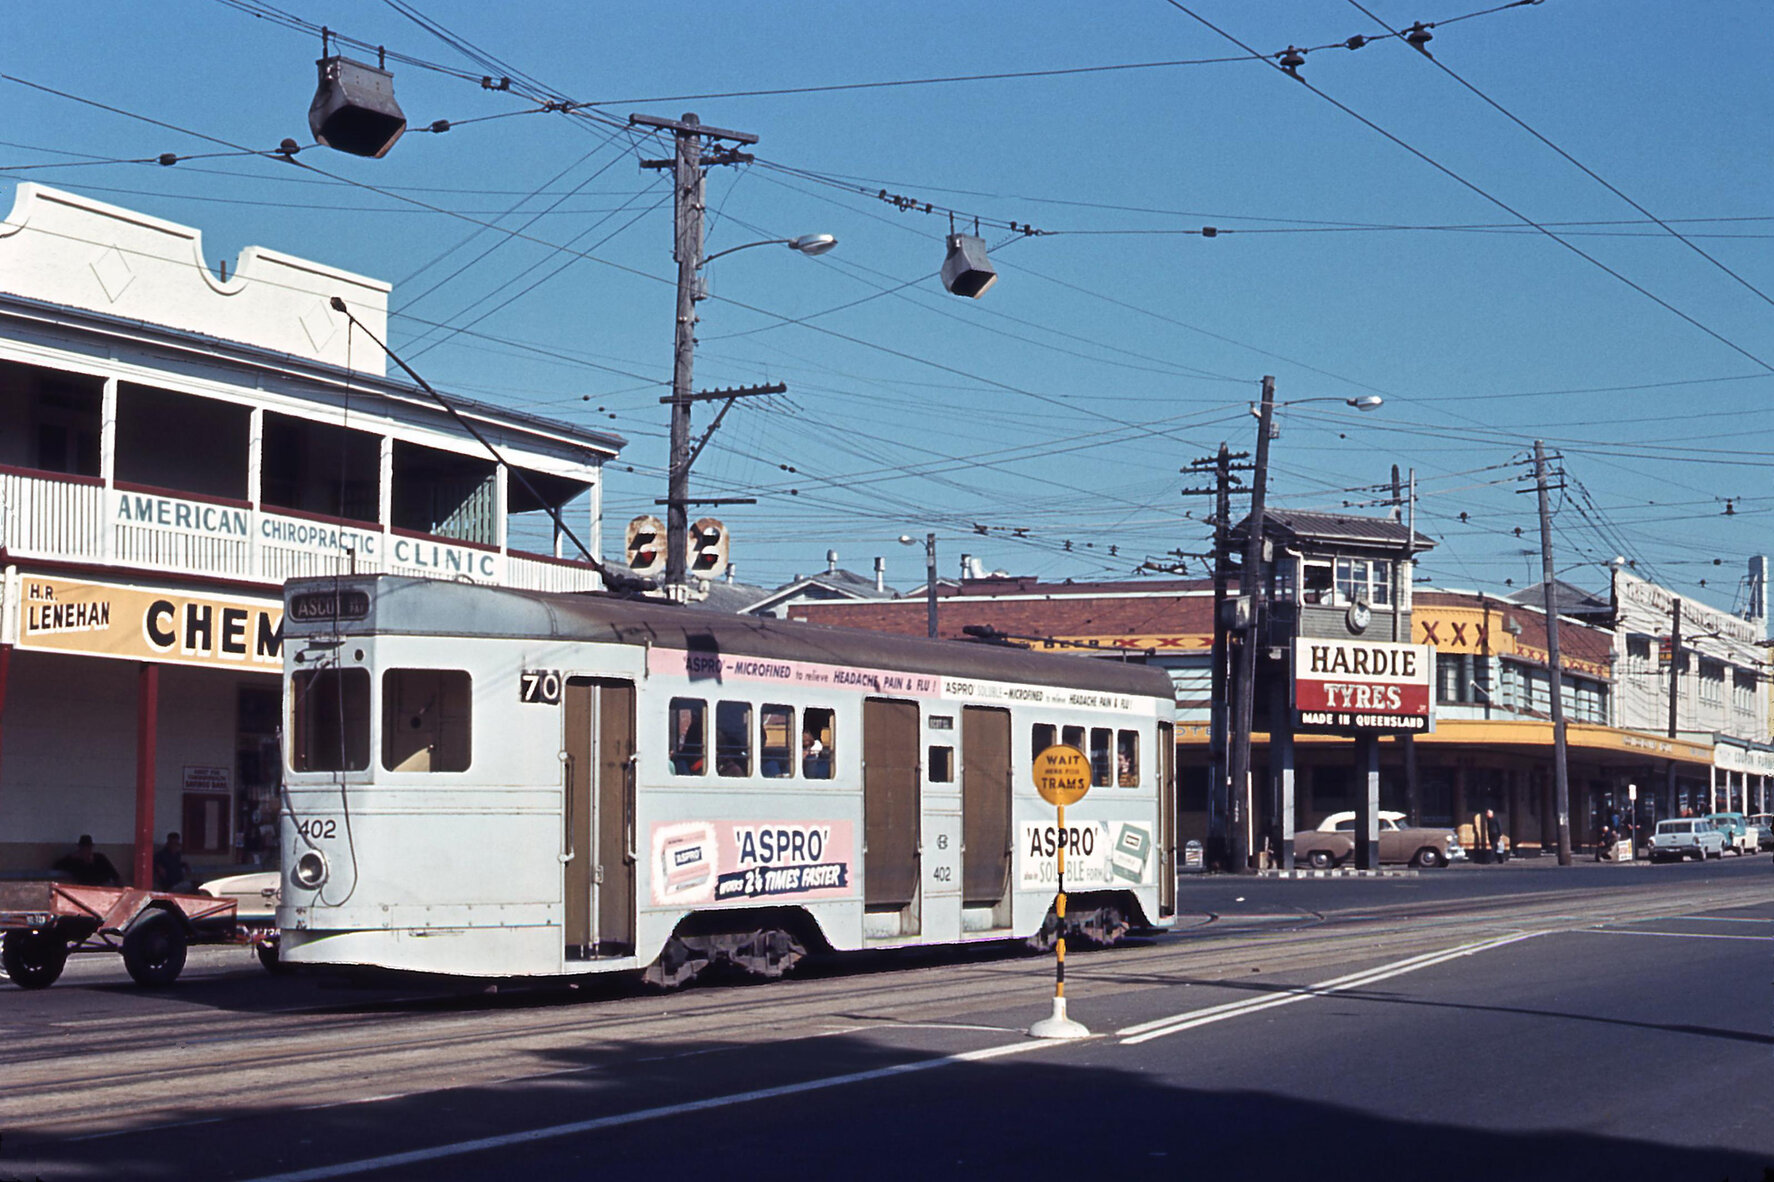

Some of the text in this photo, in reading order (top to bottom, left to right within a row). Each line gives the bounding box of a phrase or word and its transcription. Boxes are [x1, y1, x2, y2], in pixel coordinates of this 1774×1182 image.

[118, 494, 247, 535] AMERICAN
[261, 518, 375, 554] CHIROPRACTIC
[395, 540, 494, 576] CLINIC
[30, 583, 58, 601] H.R.
[29, 601, 110, 630] LENEHAN
[146, 600, 284, 657] CHEM
[1310, 645, 1416, 677] HARDIE
[522, 674, 559, 701] 70
[734, 661, 791, 678] MICROFINED
[833, 671, 879, 688] HEADACHE
[883, 676, 904, 690] PAIN
[906, 679, 912, 691] &
[1009, 688, 1043, 703] MICROFINED
[1069, 693, 1097, 708] HEADACHE
[1323, 683, 1402, 710] TYRES
[1302, 712, 1424, 728] MADE IN QUEENSLAND
[1046, 755, 1080, 765] WAIT
[1041, 777, 1085, 790] TRAMS
[297, 819, 336, 839] 402
[765, 869, 800, 891] TIMES
[801, 865, 841, 887] FASTER
[933, 866, 951, 882] 402
